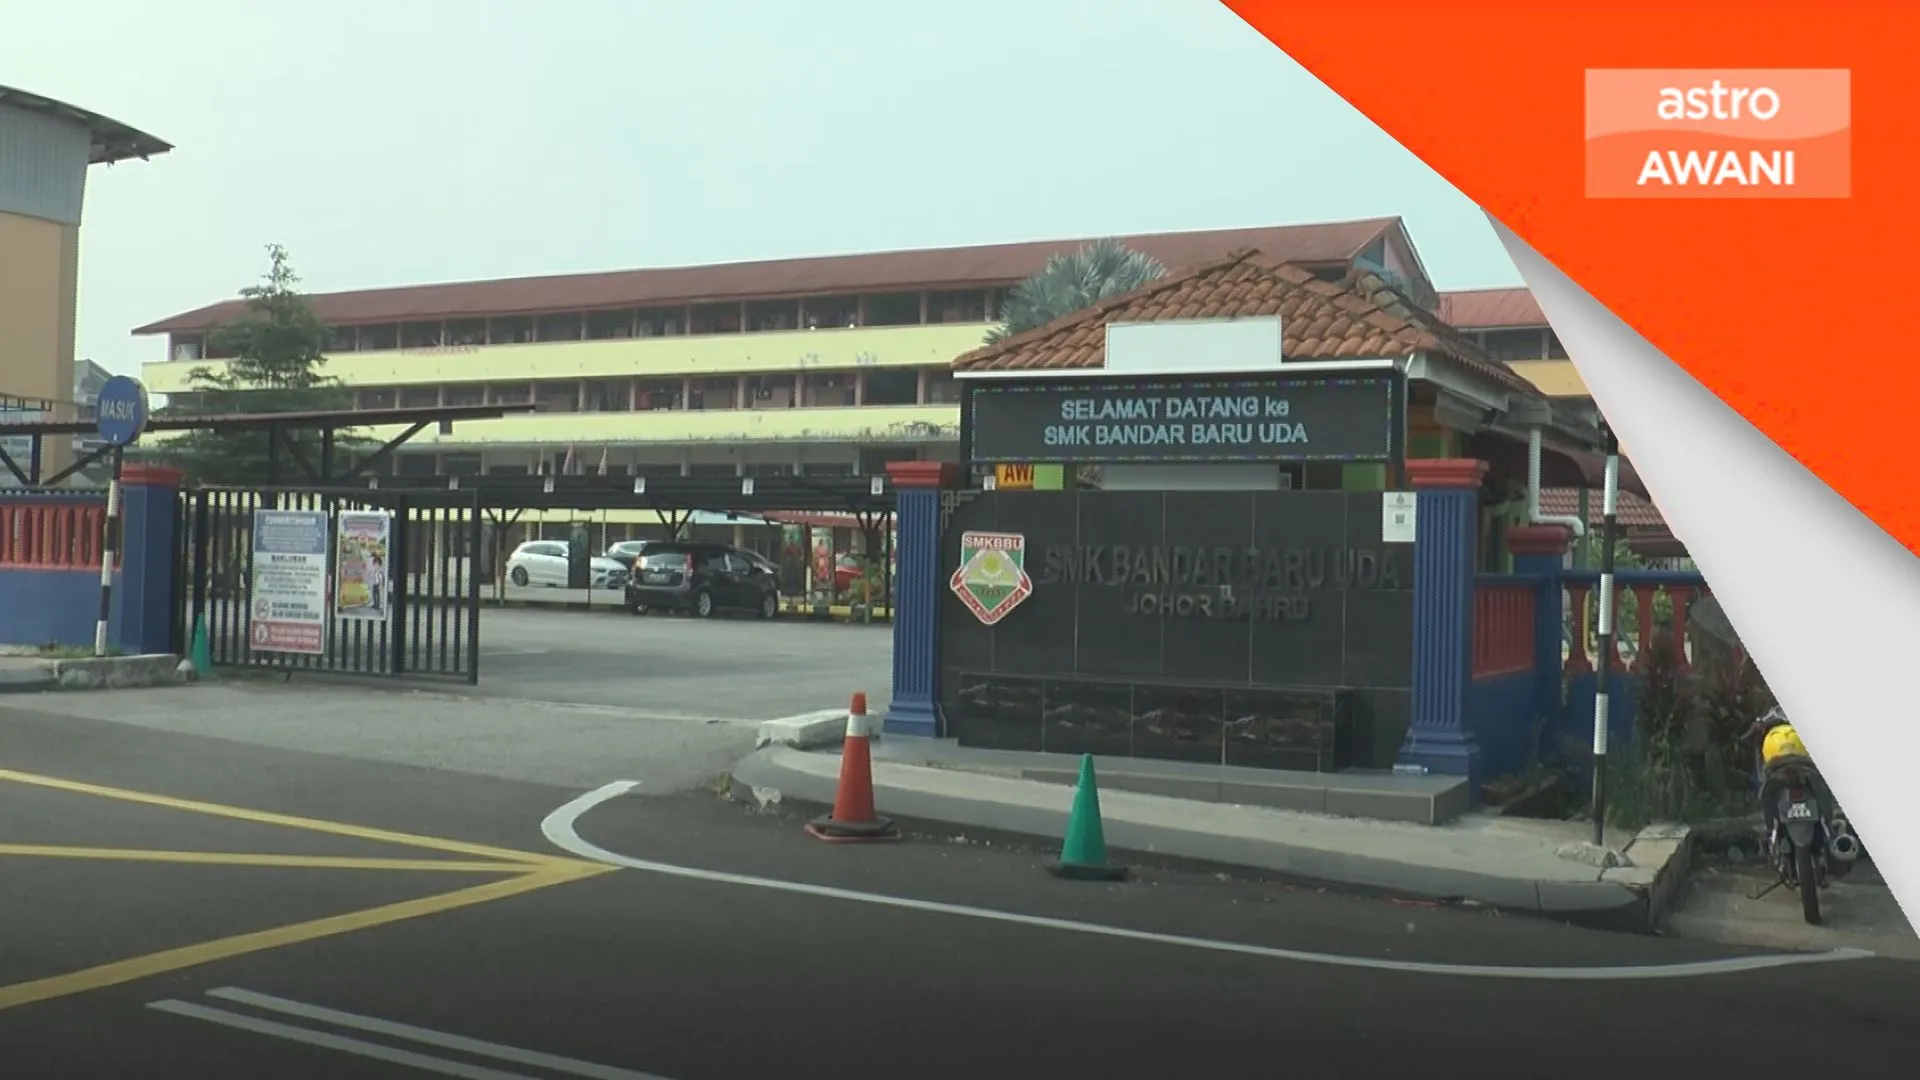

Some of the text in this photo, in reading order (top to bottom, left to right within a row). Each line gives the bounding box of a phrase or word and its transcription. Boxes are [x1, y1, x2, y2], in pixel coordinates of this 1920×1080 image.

[100, 399, 136, 421] MASUK
[1061, 396, 1289, 420] SELAMAT DATANG ke
[1044, 423, 1308, 445] SMK BANDAR BARU UDA
[964, 536, 1022, 551] SMKBBU
[1044, 546, 1400, 588] SMK BANDAR BARU UDA
[1127, 592, 1311, 620] JOHOR BAHRU
